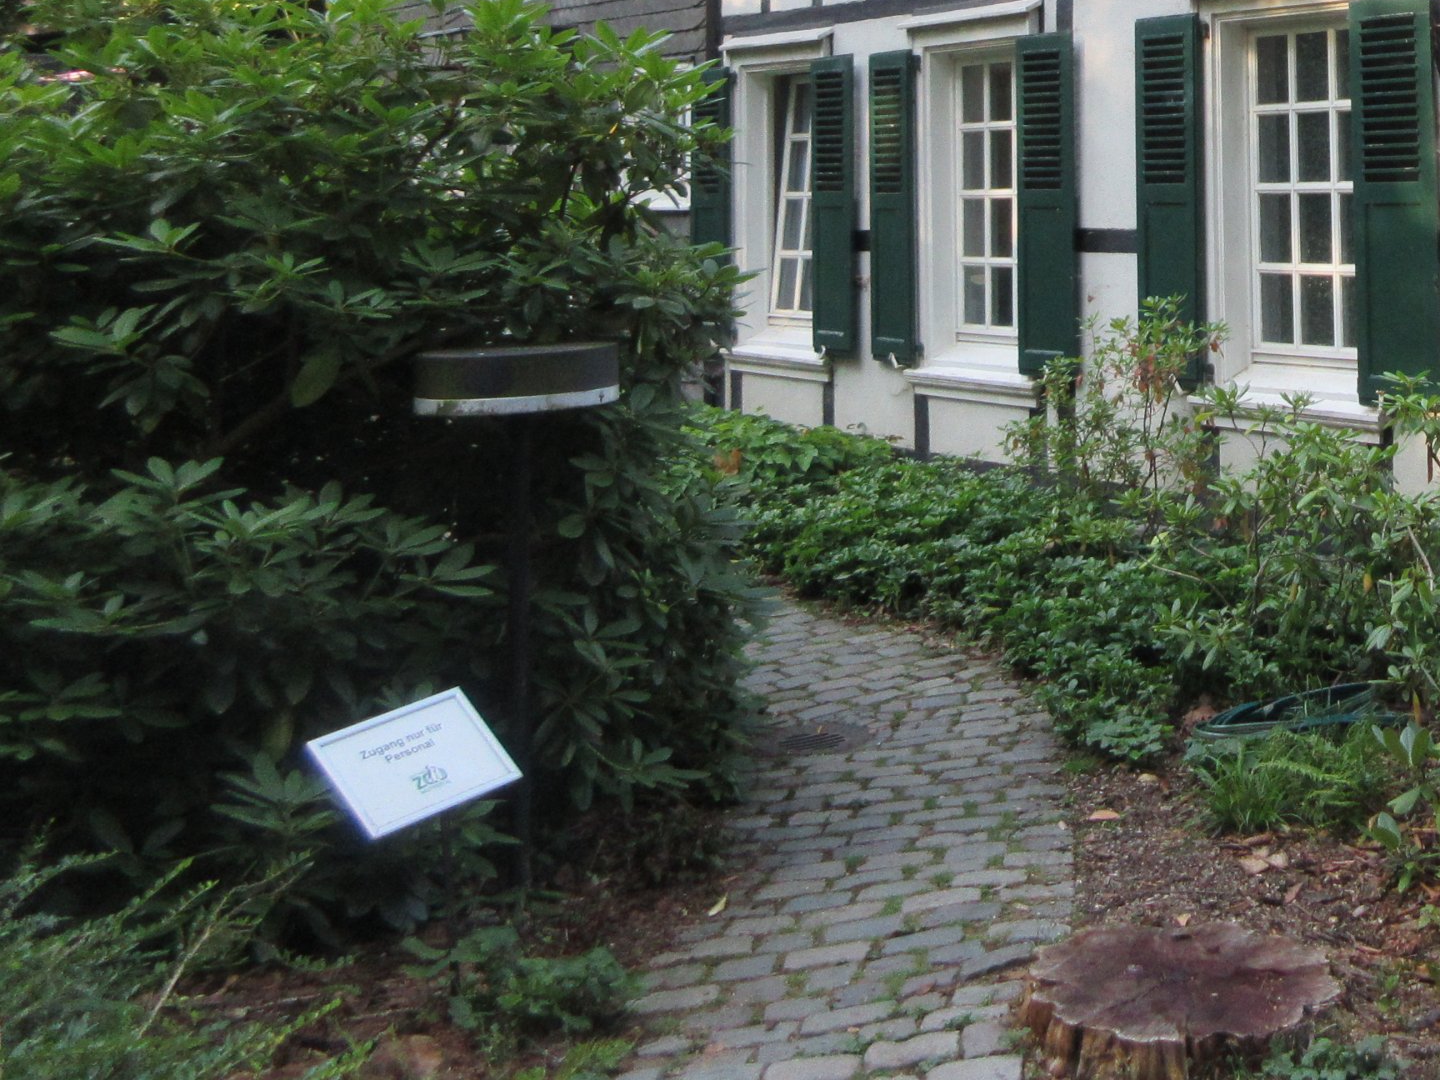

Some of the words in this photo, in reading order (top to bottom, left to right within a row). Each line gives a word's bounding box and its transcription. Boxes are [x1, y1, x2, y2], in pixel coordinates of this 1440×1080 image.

[360, 737, 405, 760] Zugang
[405, 729, 425, 743] nur
[425, 722, 442, 734] für
[385, 738, 436, 763] Personal
